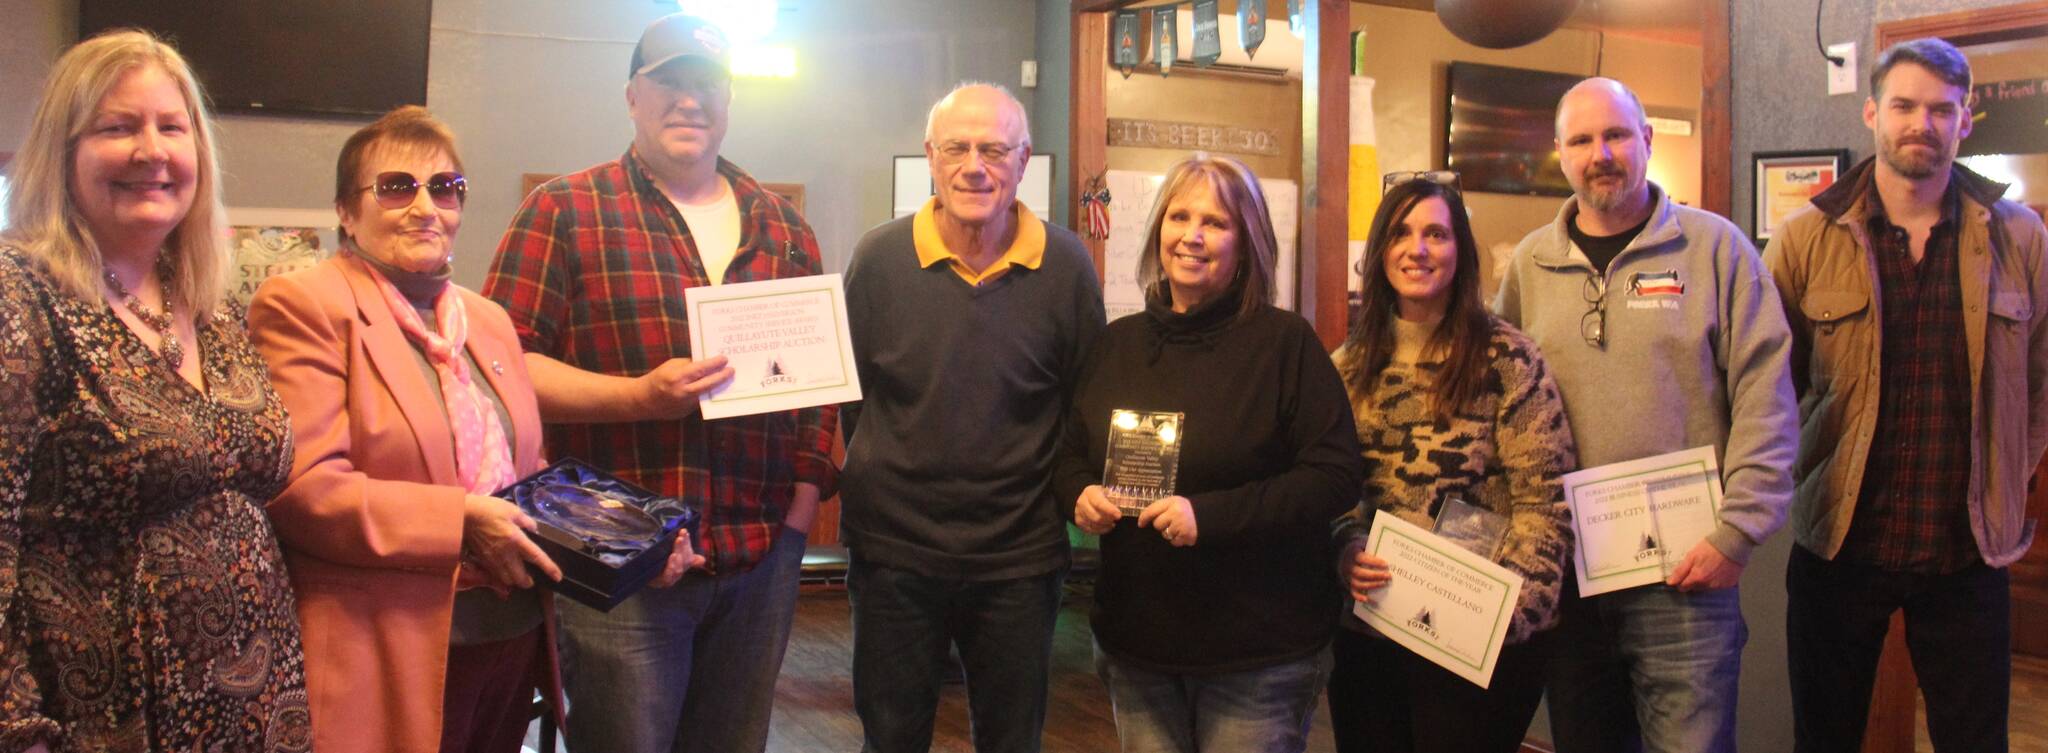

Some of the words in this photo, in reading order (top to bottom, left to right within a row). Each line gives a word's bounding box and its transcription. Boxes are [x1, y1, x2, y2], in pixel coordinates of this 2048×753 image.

[722, 329, 782, 345] QUILLAYUTE
[782, 325, 817, 337] VALLEY
[783, 335, 825, 348] AUCTION
[1586, 511, 1622, 525] DECKER
[1623, 506, 1645, 518] CITY
[1650, 496, 1701, 512] HARDWARE
[1455, 569, 1495, 592] COMMERCE
[1464, 582, 1482, 594] YEAR
[1425, 581, 1484, 615] CASTELLANO
